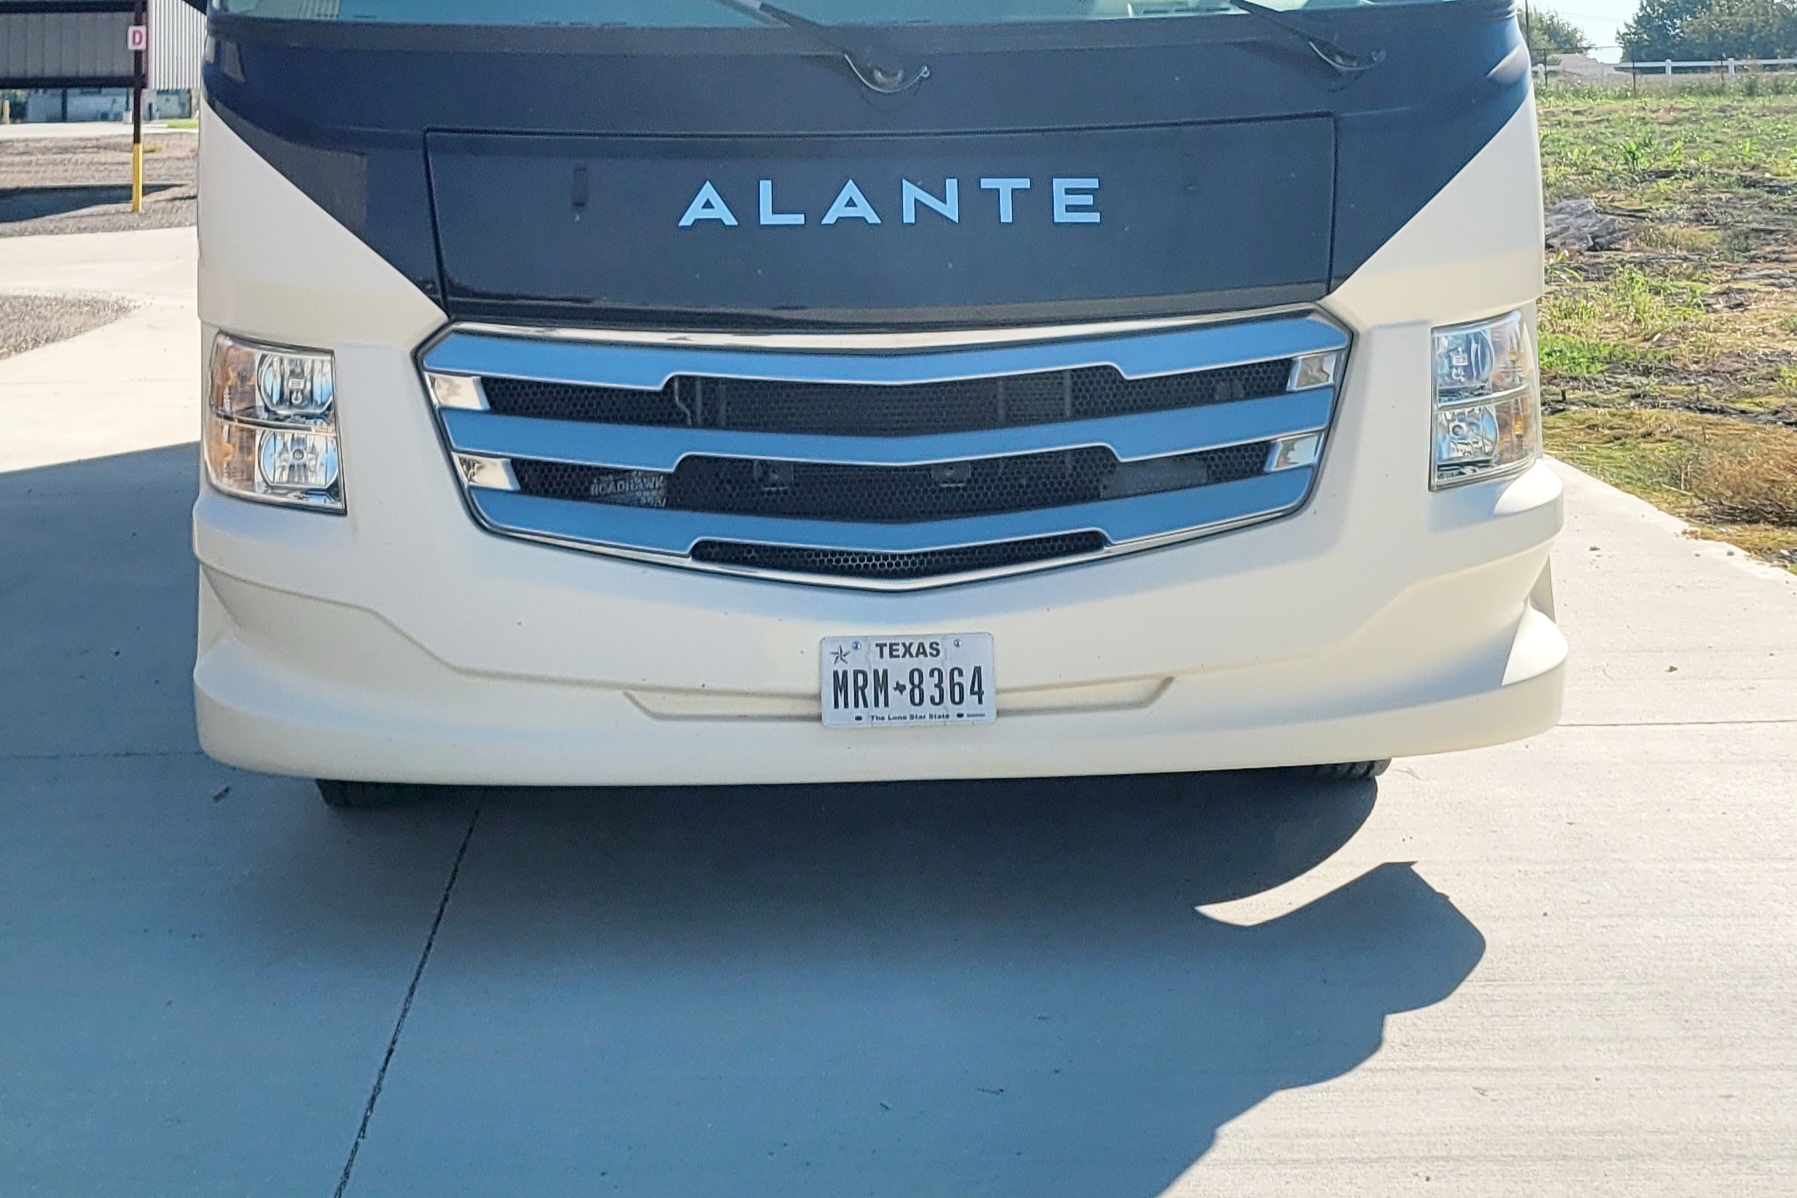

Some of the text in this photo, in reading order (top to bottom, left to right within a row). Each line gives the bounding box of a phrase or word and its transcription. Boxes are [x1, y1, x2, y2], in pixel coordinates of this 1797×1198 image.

[132, 28, 143, 46] D
[678, 177, 1101, 227] ALANTE
[875, 641, 941, 659] TEXAS
